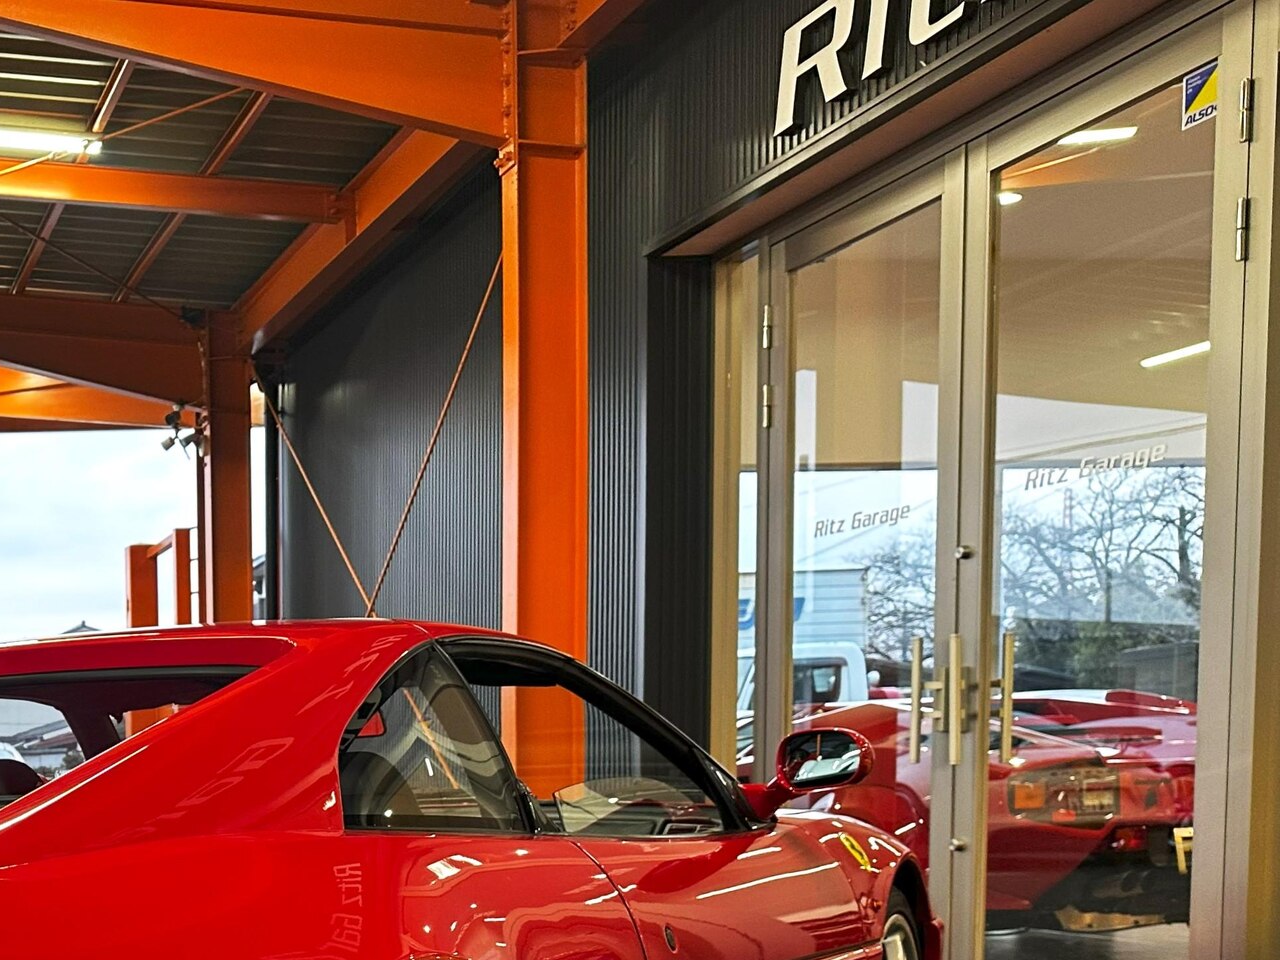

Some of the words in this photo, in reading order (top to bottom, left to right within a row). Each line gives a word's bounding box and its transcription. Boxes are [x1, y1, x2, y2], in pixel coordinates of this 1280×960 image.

[1024, 466, 1070, 491] Ritz
[1078, 443, 1167, 479] Garage
[814, 519, 845, 539] Ritz
[851, 504, 911, 531] Garage
